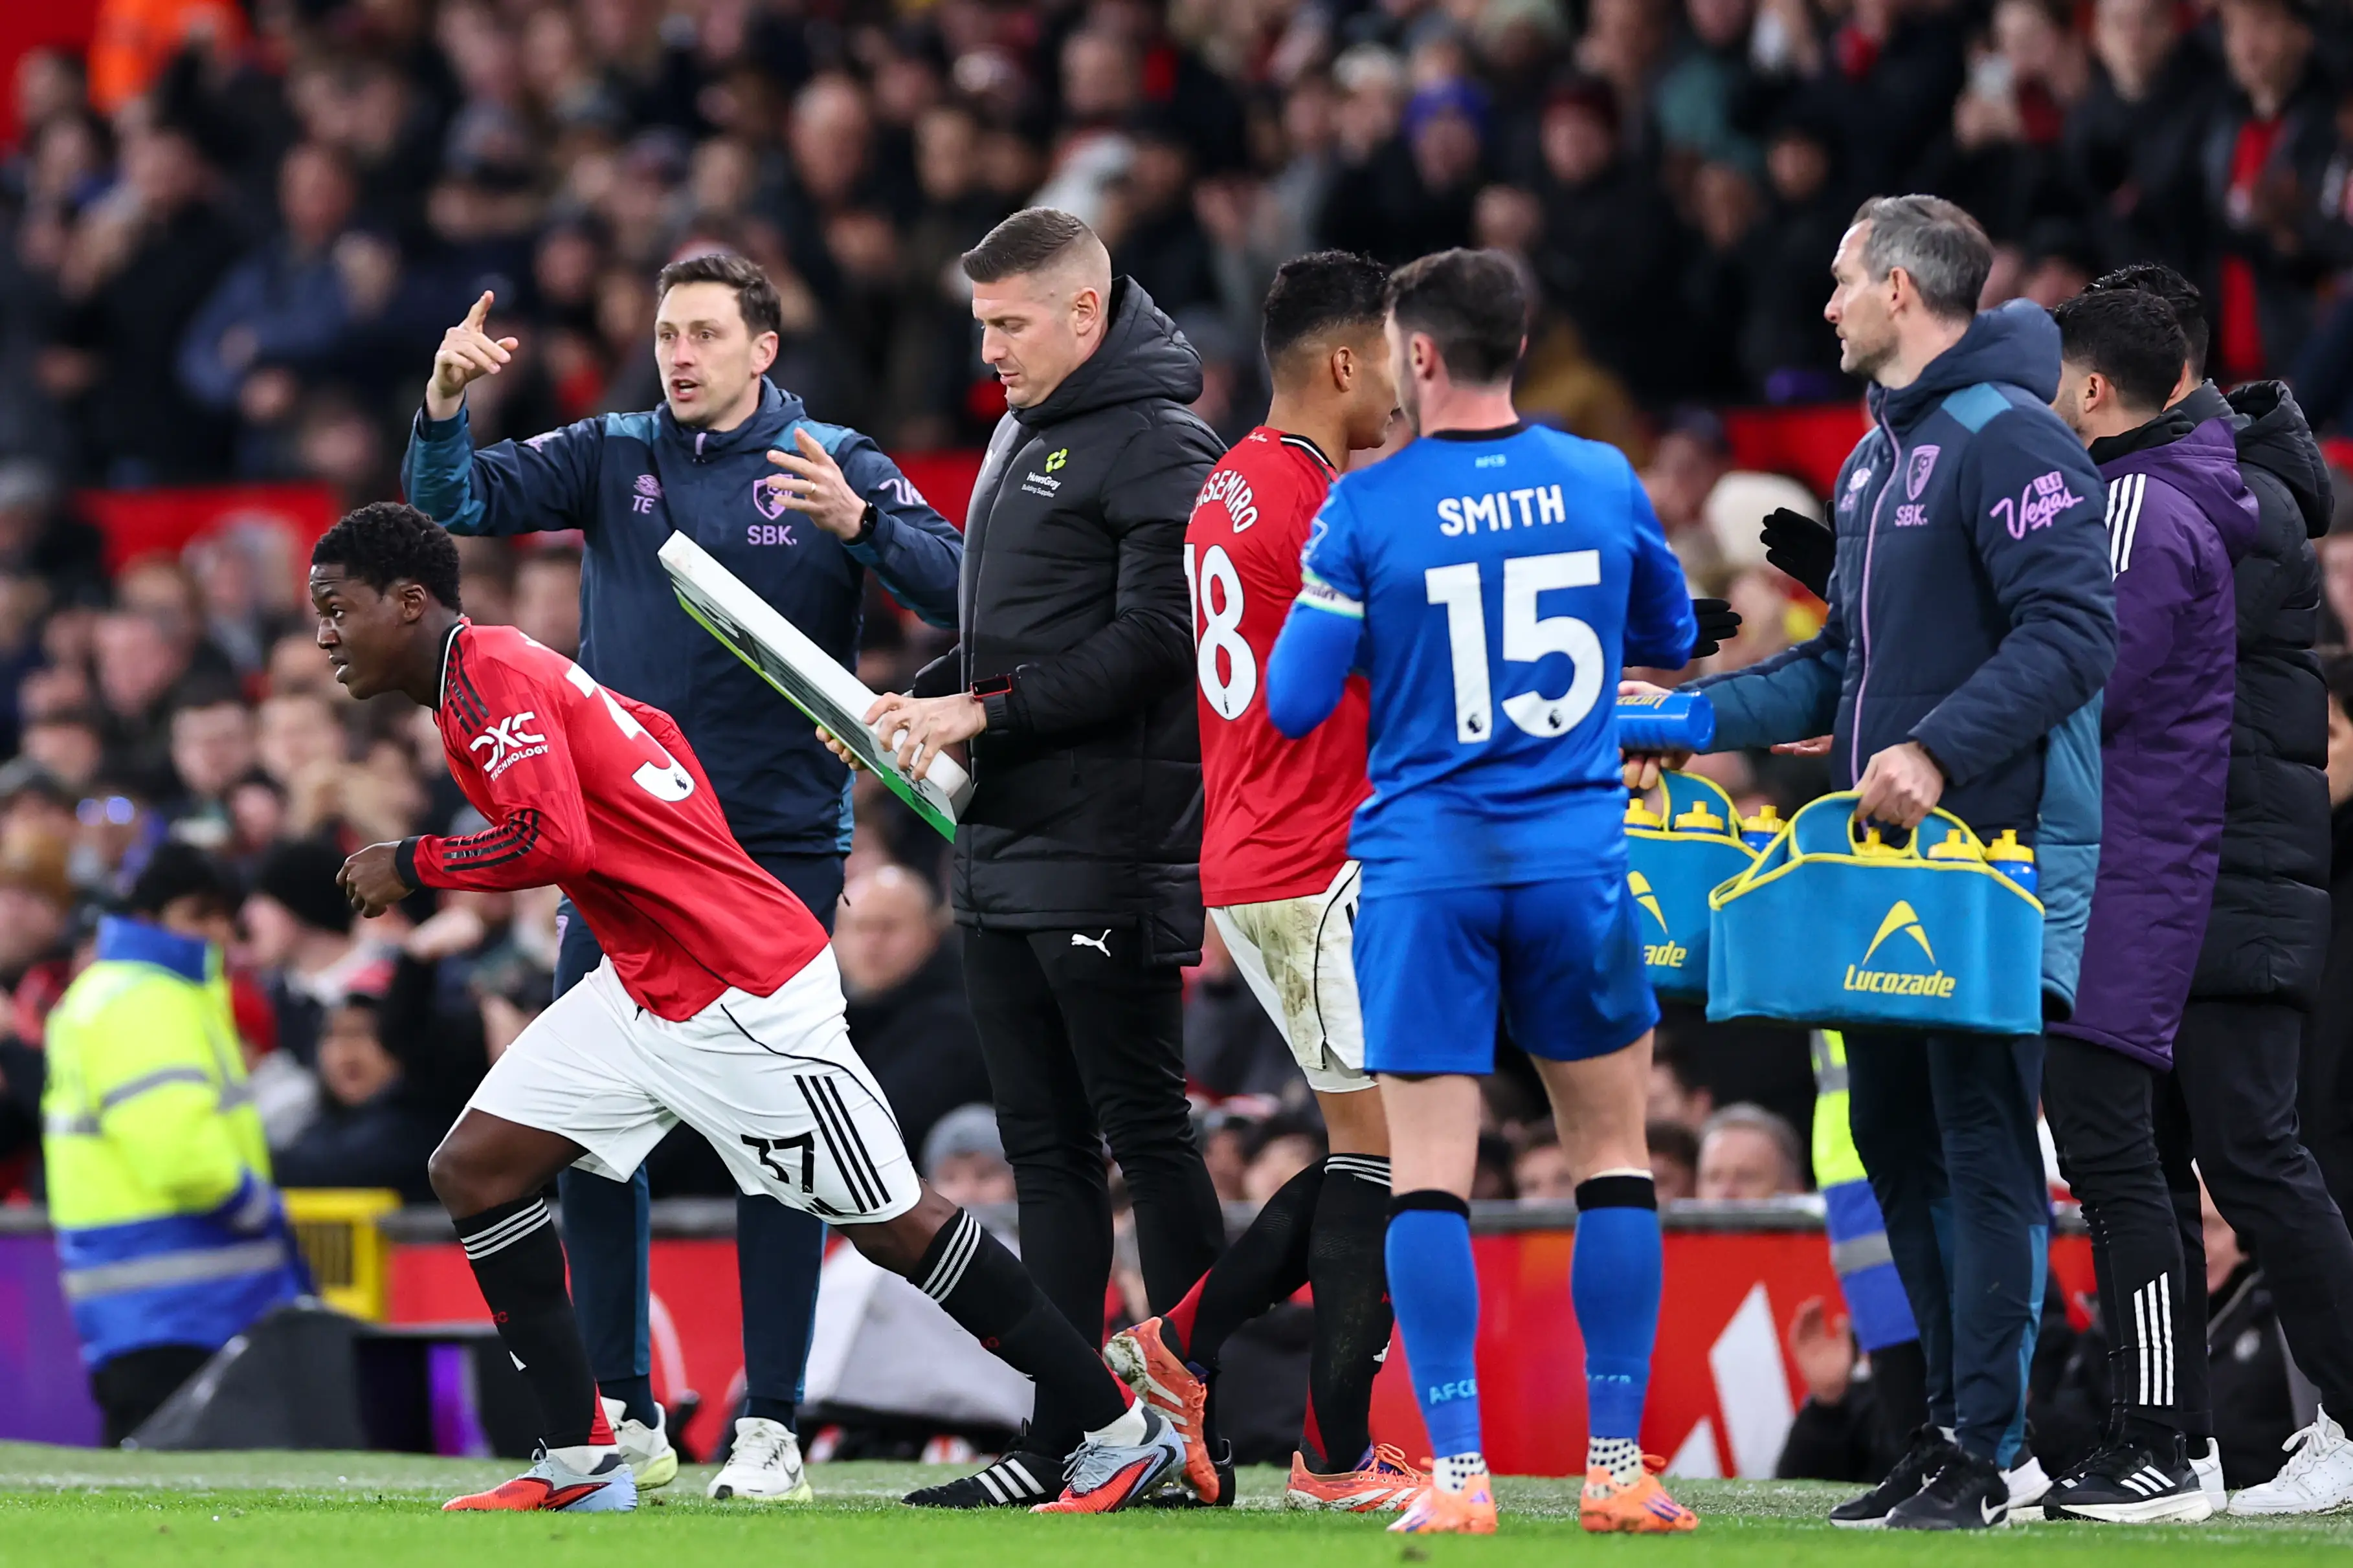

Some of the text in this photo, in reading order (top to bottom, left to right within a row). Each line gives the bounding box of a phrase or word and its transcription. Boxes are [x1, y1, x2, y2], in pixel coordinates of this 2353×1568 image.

[632, 494, 655, 514] TE
[1188, 469, 1258, 534] SEMIRO
[2035, 472, 2062, 494] LAS
[1437, 485, 1566, 536] SMITH
[1989, 482, 2084, 540] Vegas
[1425, 549, 1604, 744] 15
[469, 711, 546, 772] DXC
[490, 744, 550, 782] TECHNOLOGY
[1844, 964, 1956, 999] Lucozade
[741, 1131, 815, 1194] 37
